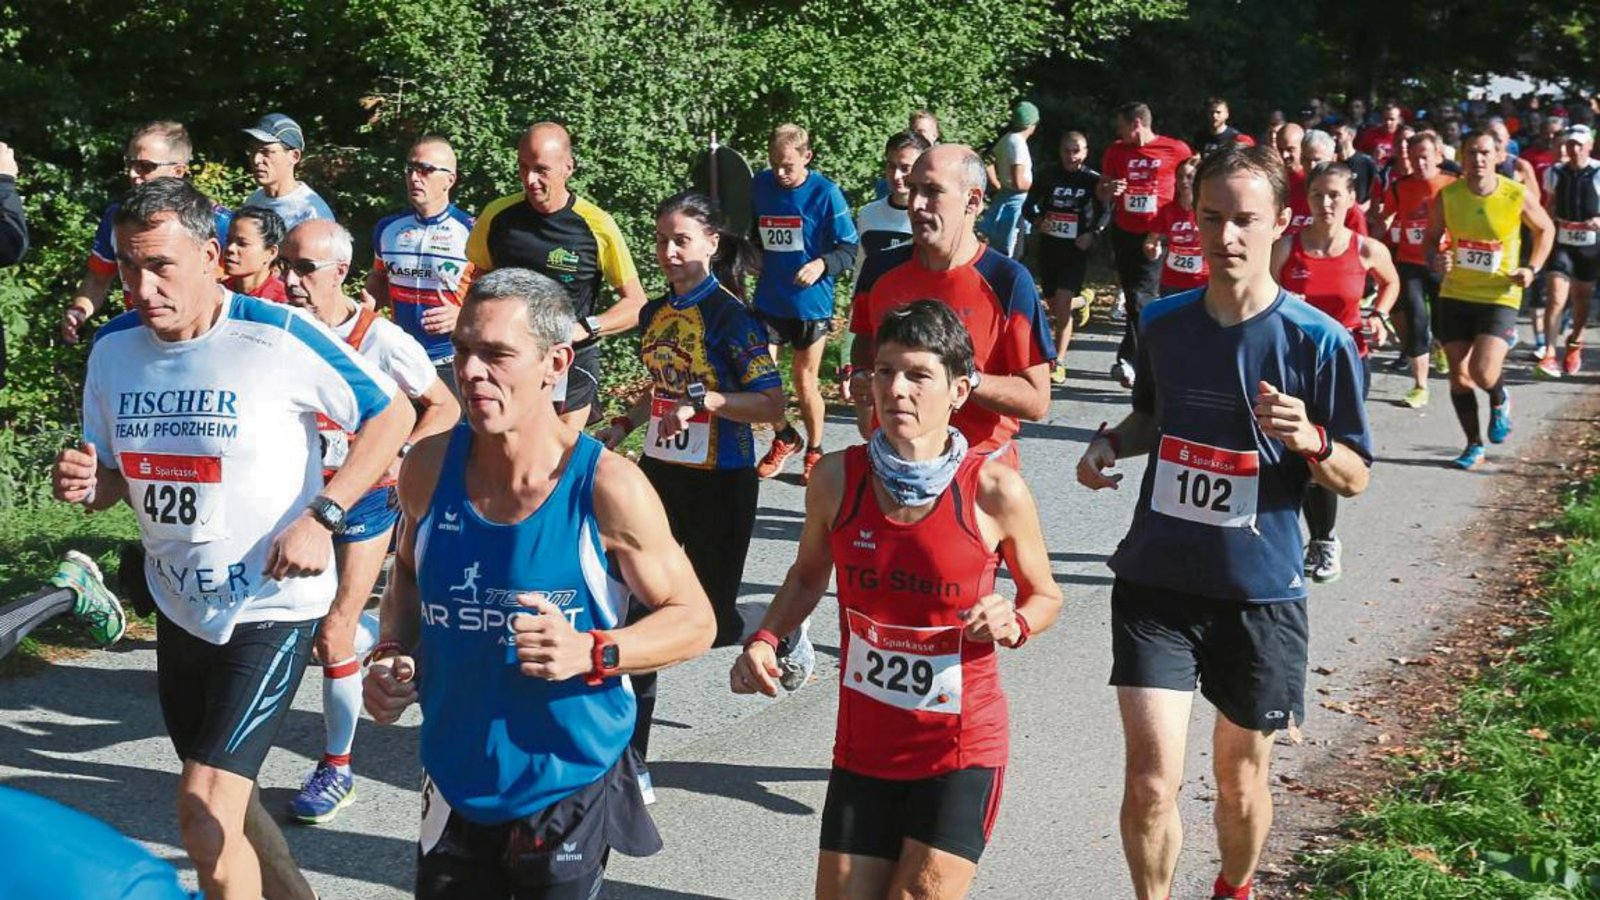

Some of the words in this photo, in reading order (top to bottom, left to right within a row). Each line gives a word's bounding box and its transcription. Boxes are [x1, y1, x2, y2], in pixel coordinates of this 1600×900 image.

[1129, 197, 1148, 208] 217
[767, 229, 793, 245] 203
[1173, 256, 1195, 269] 226
[1467, 251, 1492, 266] 373
[117, 389, 238, 416] FISCHER
[115, 423, 149, 438] TEAM
[153, 421, 238, 438] PFORZHEIM
[155, 467, 199, 478] Sparkasse
[1192, 455, 1235, 473] Sparkasse
[1177, 470, 1232, 512] 102
[144, 484, 198, 525] 428
[845, 565, 880, 591] TG
[889, 567, 961, 598] Stein
[882, 637, 935, 651] Sparkasse
[866, 650, 934, 696] 229
